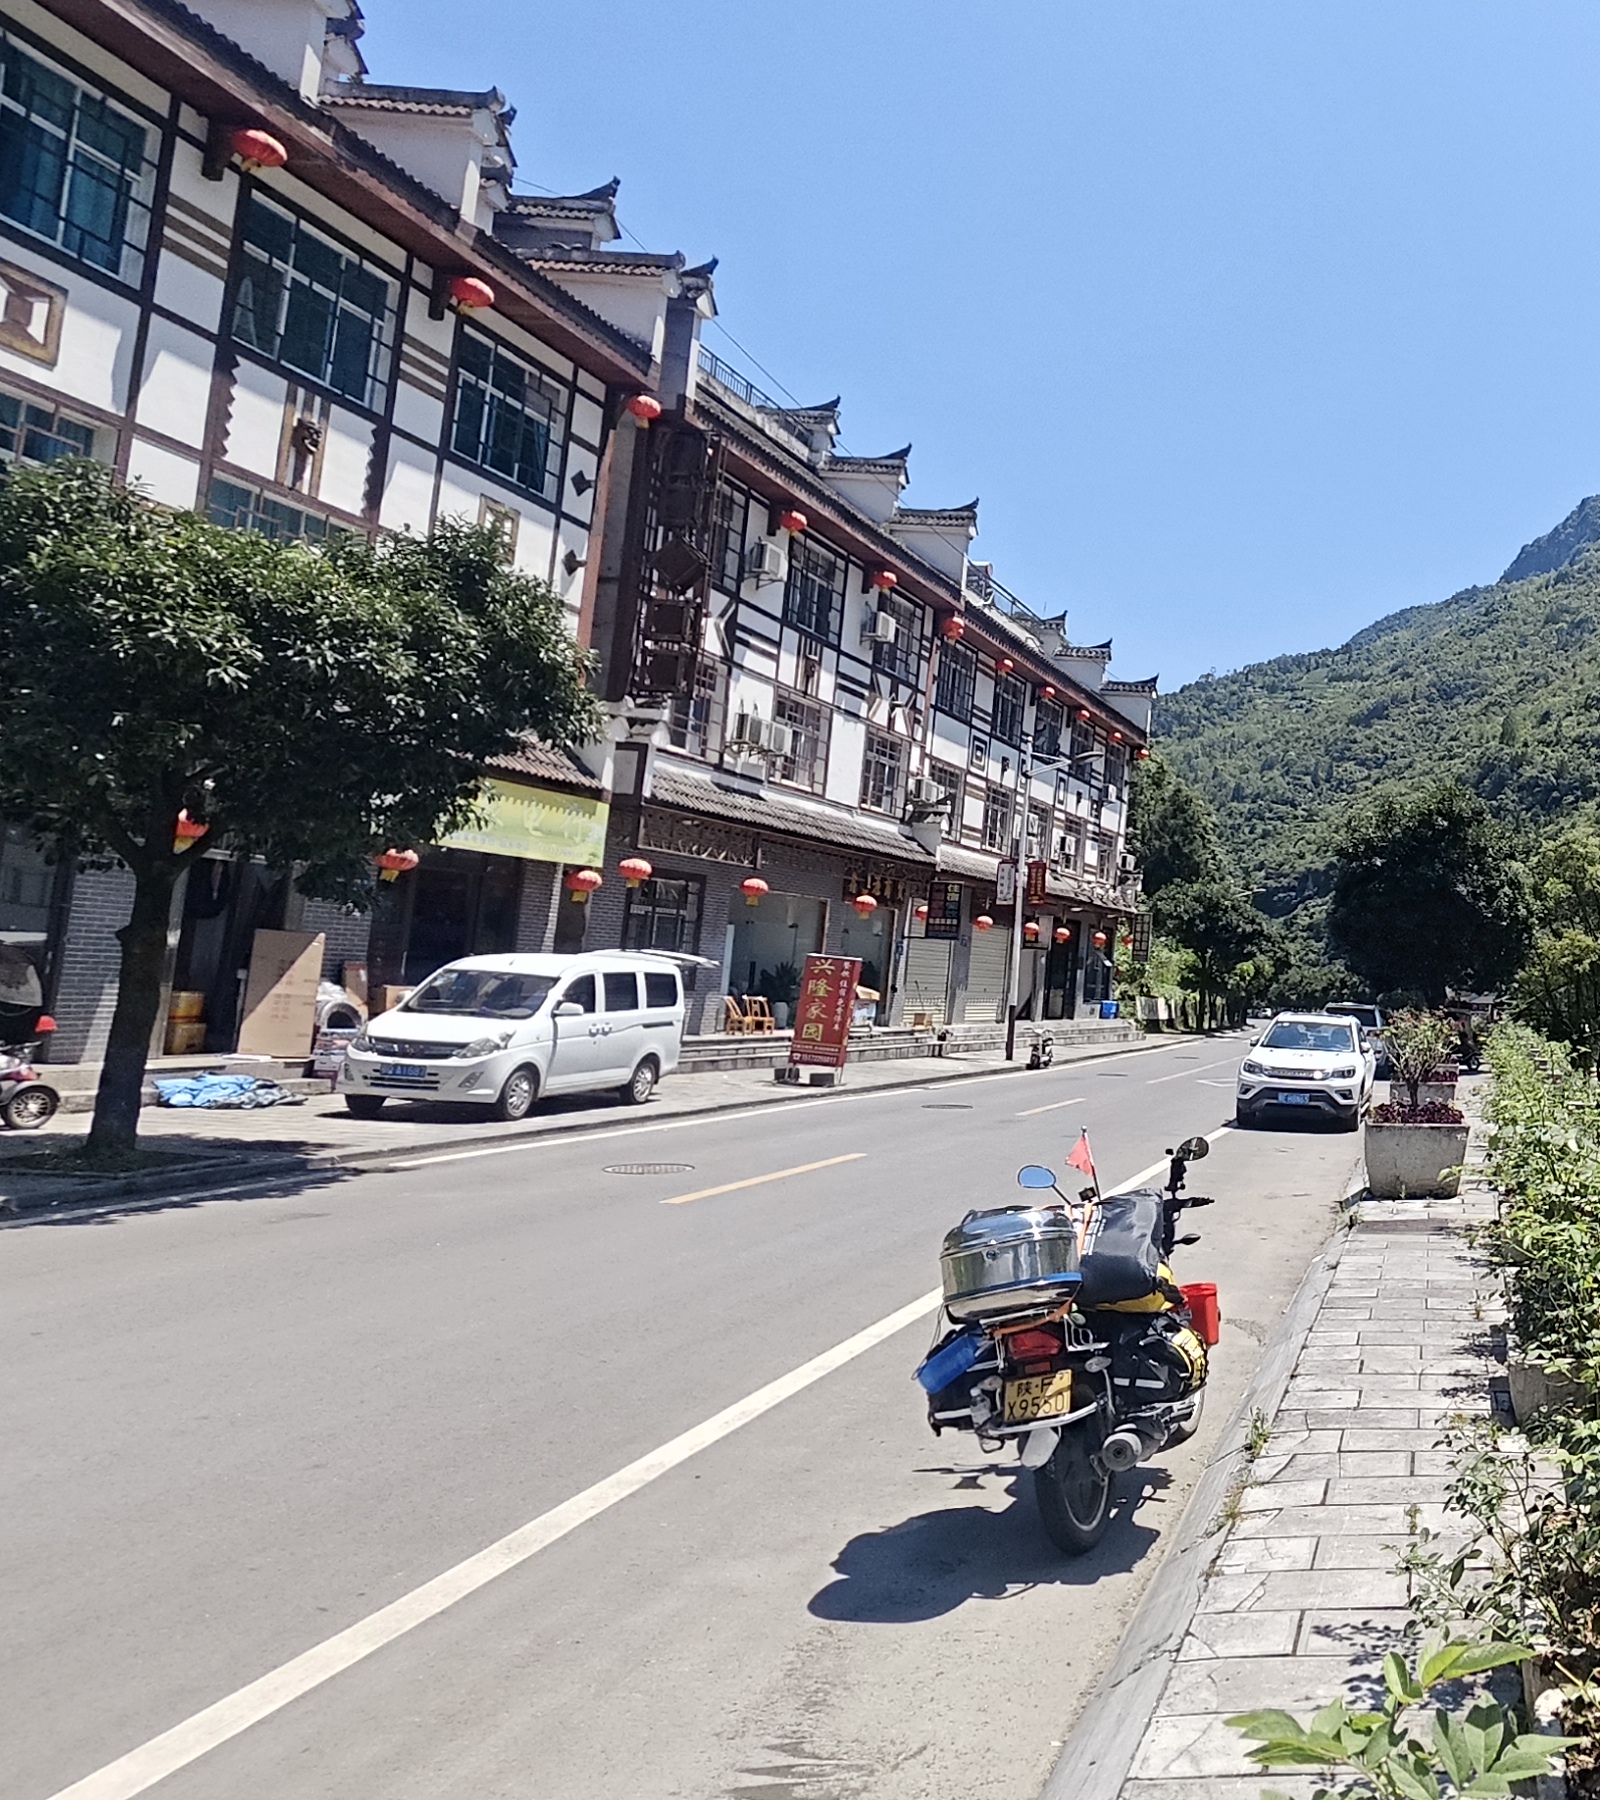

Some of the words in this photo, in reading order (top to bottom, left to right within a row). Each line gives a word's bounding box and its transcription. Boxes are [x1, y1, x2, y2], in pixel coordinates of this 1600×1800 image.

[801, 958, 836, 1042] 兴隆家园
[1007, 1392, 1064, 1421] X9550
